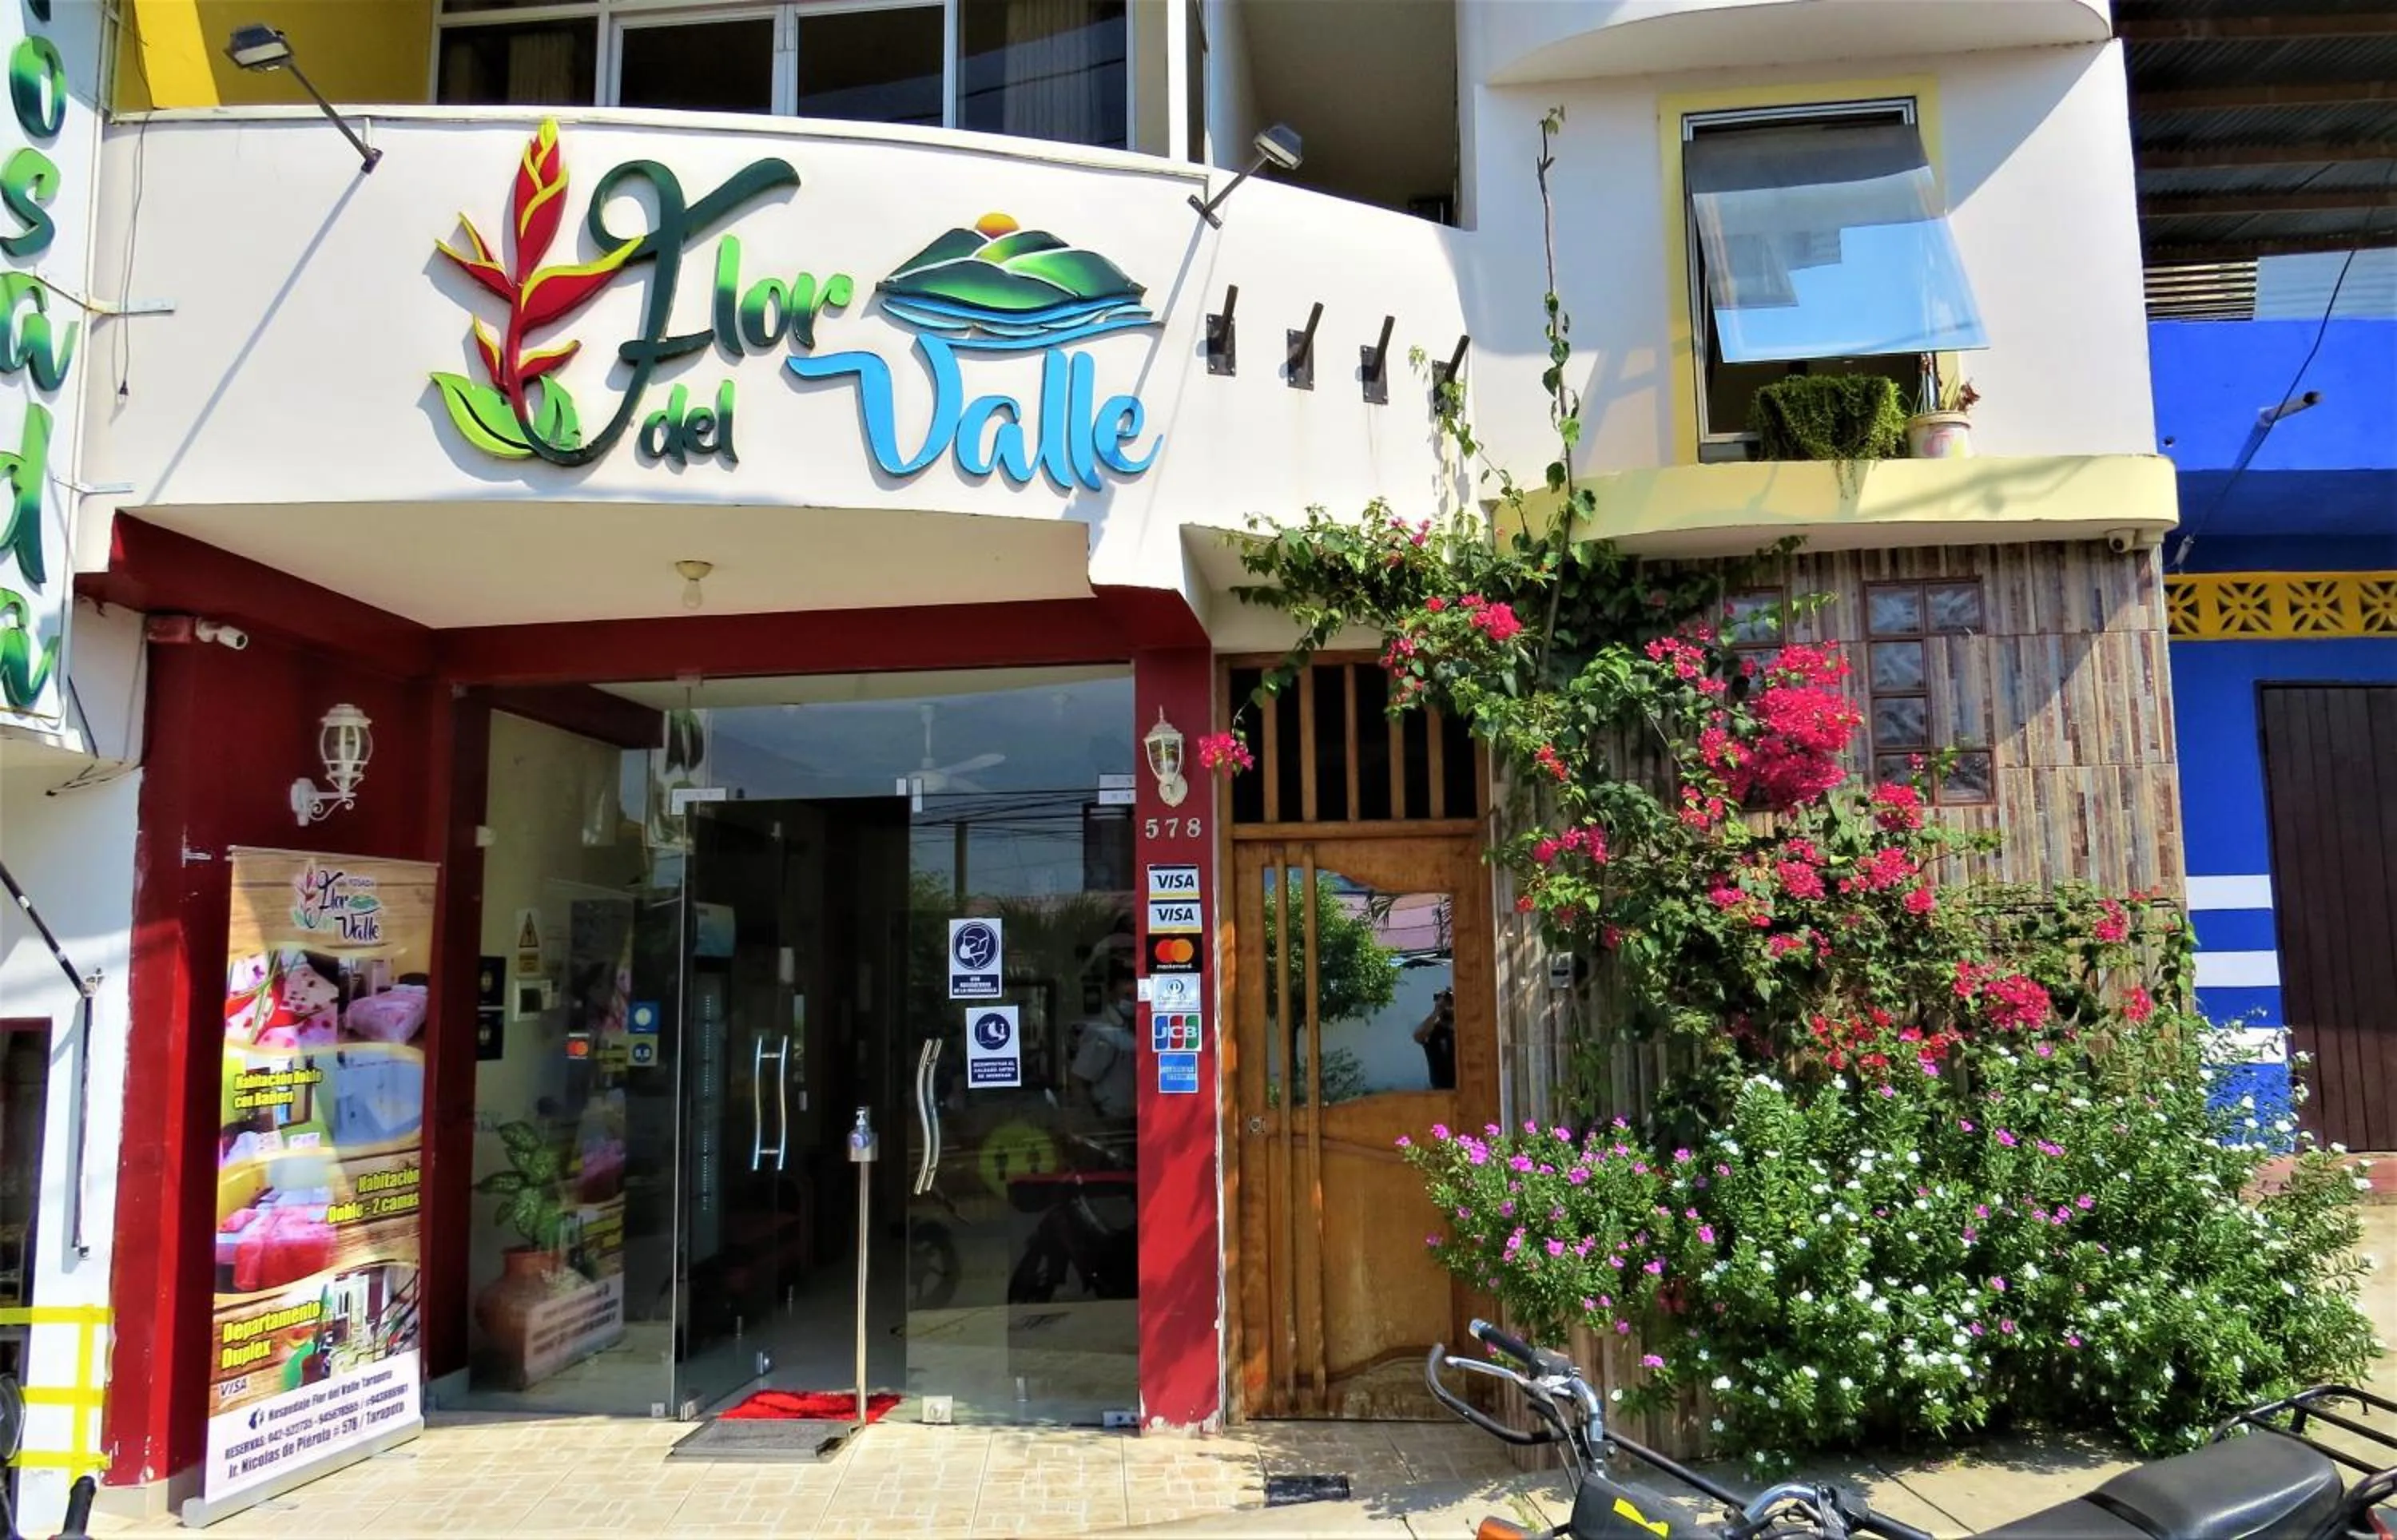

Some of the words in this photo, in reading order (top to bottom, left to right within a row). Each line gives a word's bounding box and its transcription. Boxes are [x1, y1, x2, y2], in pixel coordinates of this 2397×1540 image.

[587, 158, 853, 447] Flor
[0, 0, 78, 705] osada
[642, 378, 739, 466] del
[787, 335, 1163, 490] Valle
[1145, 817, 1202, 839] 578
[1155, 874, 1195, 889] VISA
[1156, 907, 1195, 922] VISA
[1155, 1026, 1198, 1039] JCB
[222, 1300, 321, 1344] Departamento
[221, 1340, 272, 1369] Duplex
[220, 1377, 247, 1396] VISA
[282, 1442, 295, 1458] de
